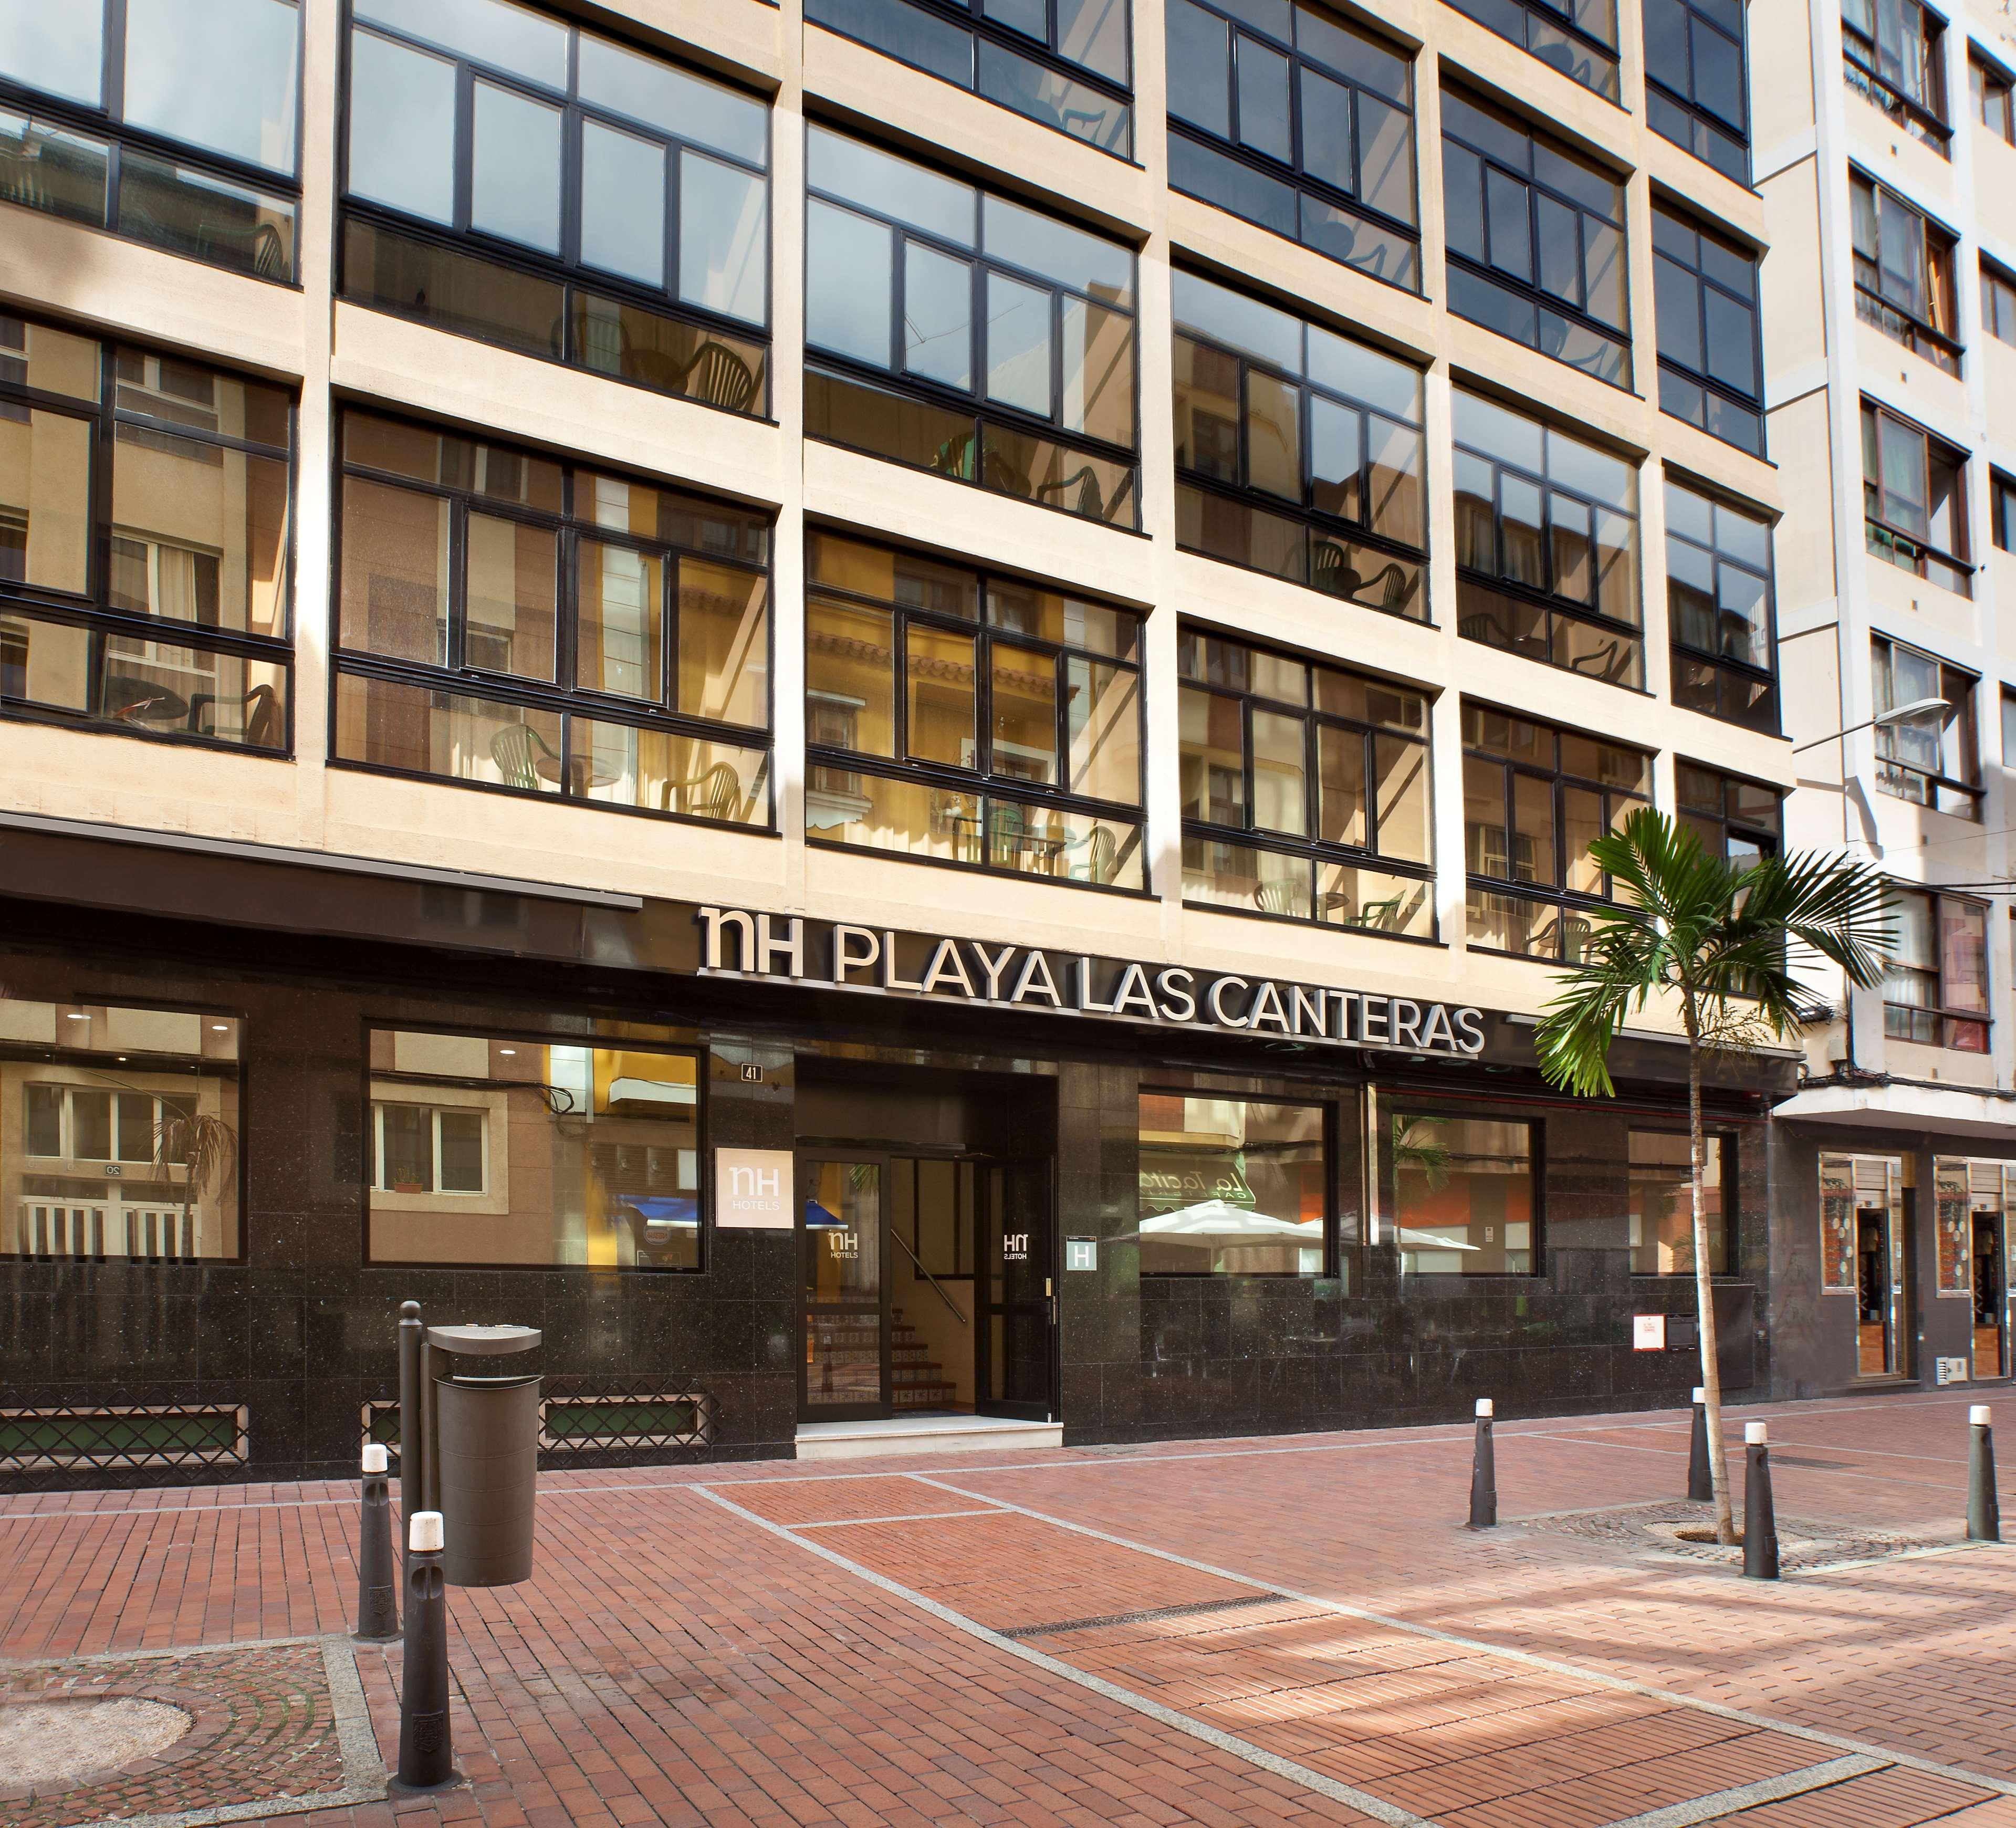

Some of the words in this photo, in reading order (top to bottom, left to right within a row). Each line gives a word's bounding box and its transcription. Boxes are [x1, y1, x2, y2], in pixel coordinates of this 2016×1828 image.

[833, 924, 1062, 1007] PLAYA
[1078, 957, 1196, 1021] LAS
[1208, 976, 1485, 1053] CANTERAS
[746, 1067, 756, 1080] 41
[733, 1200, 780, 1210] HOTELS
[1074, 1245, 1089, 1267] H
